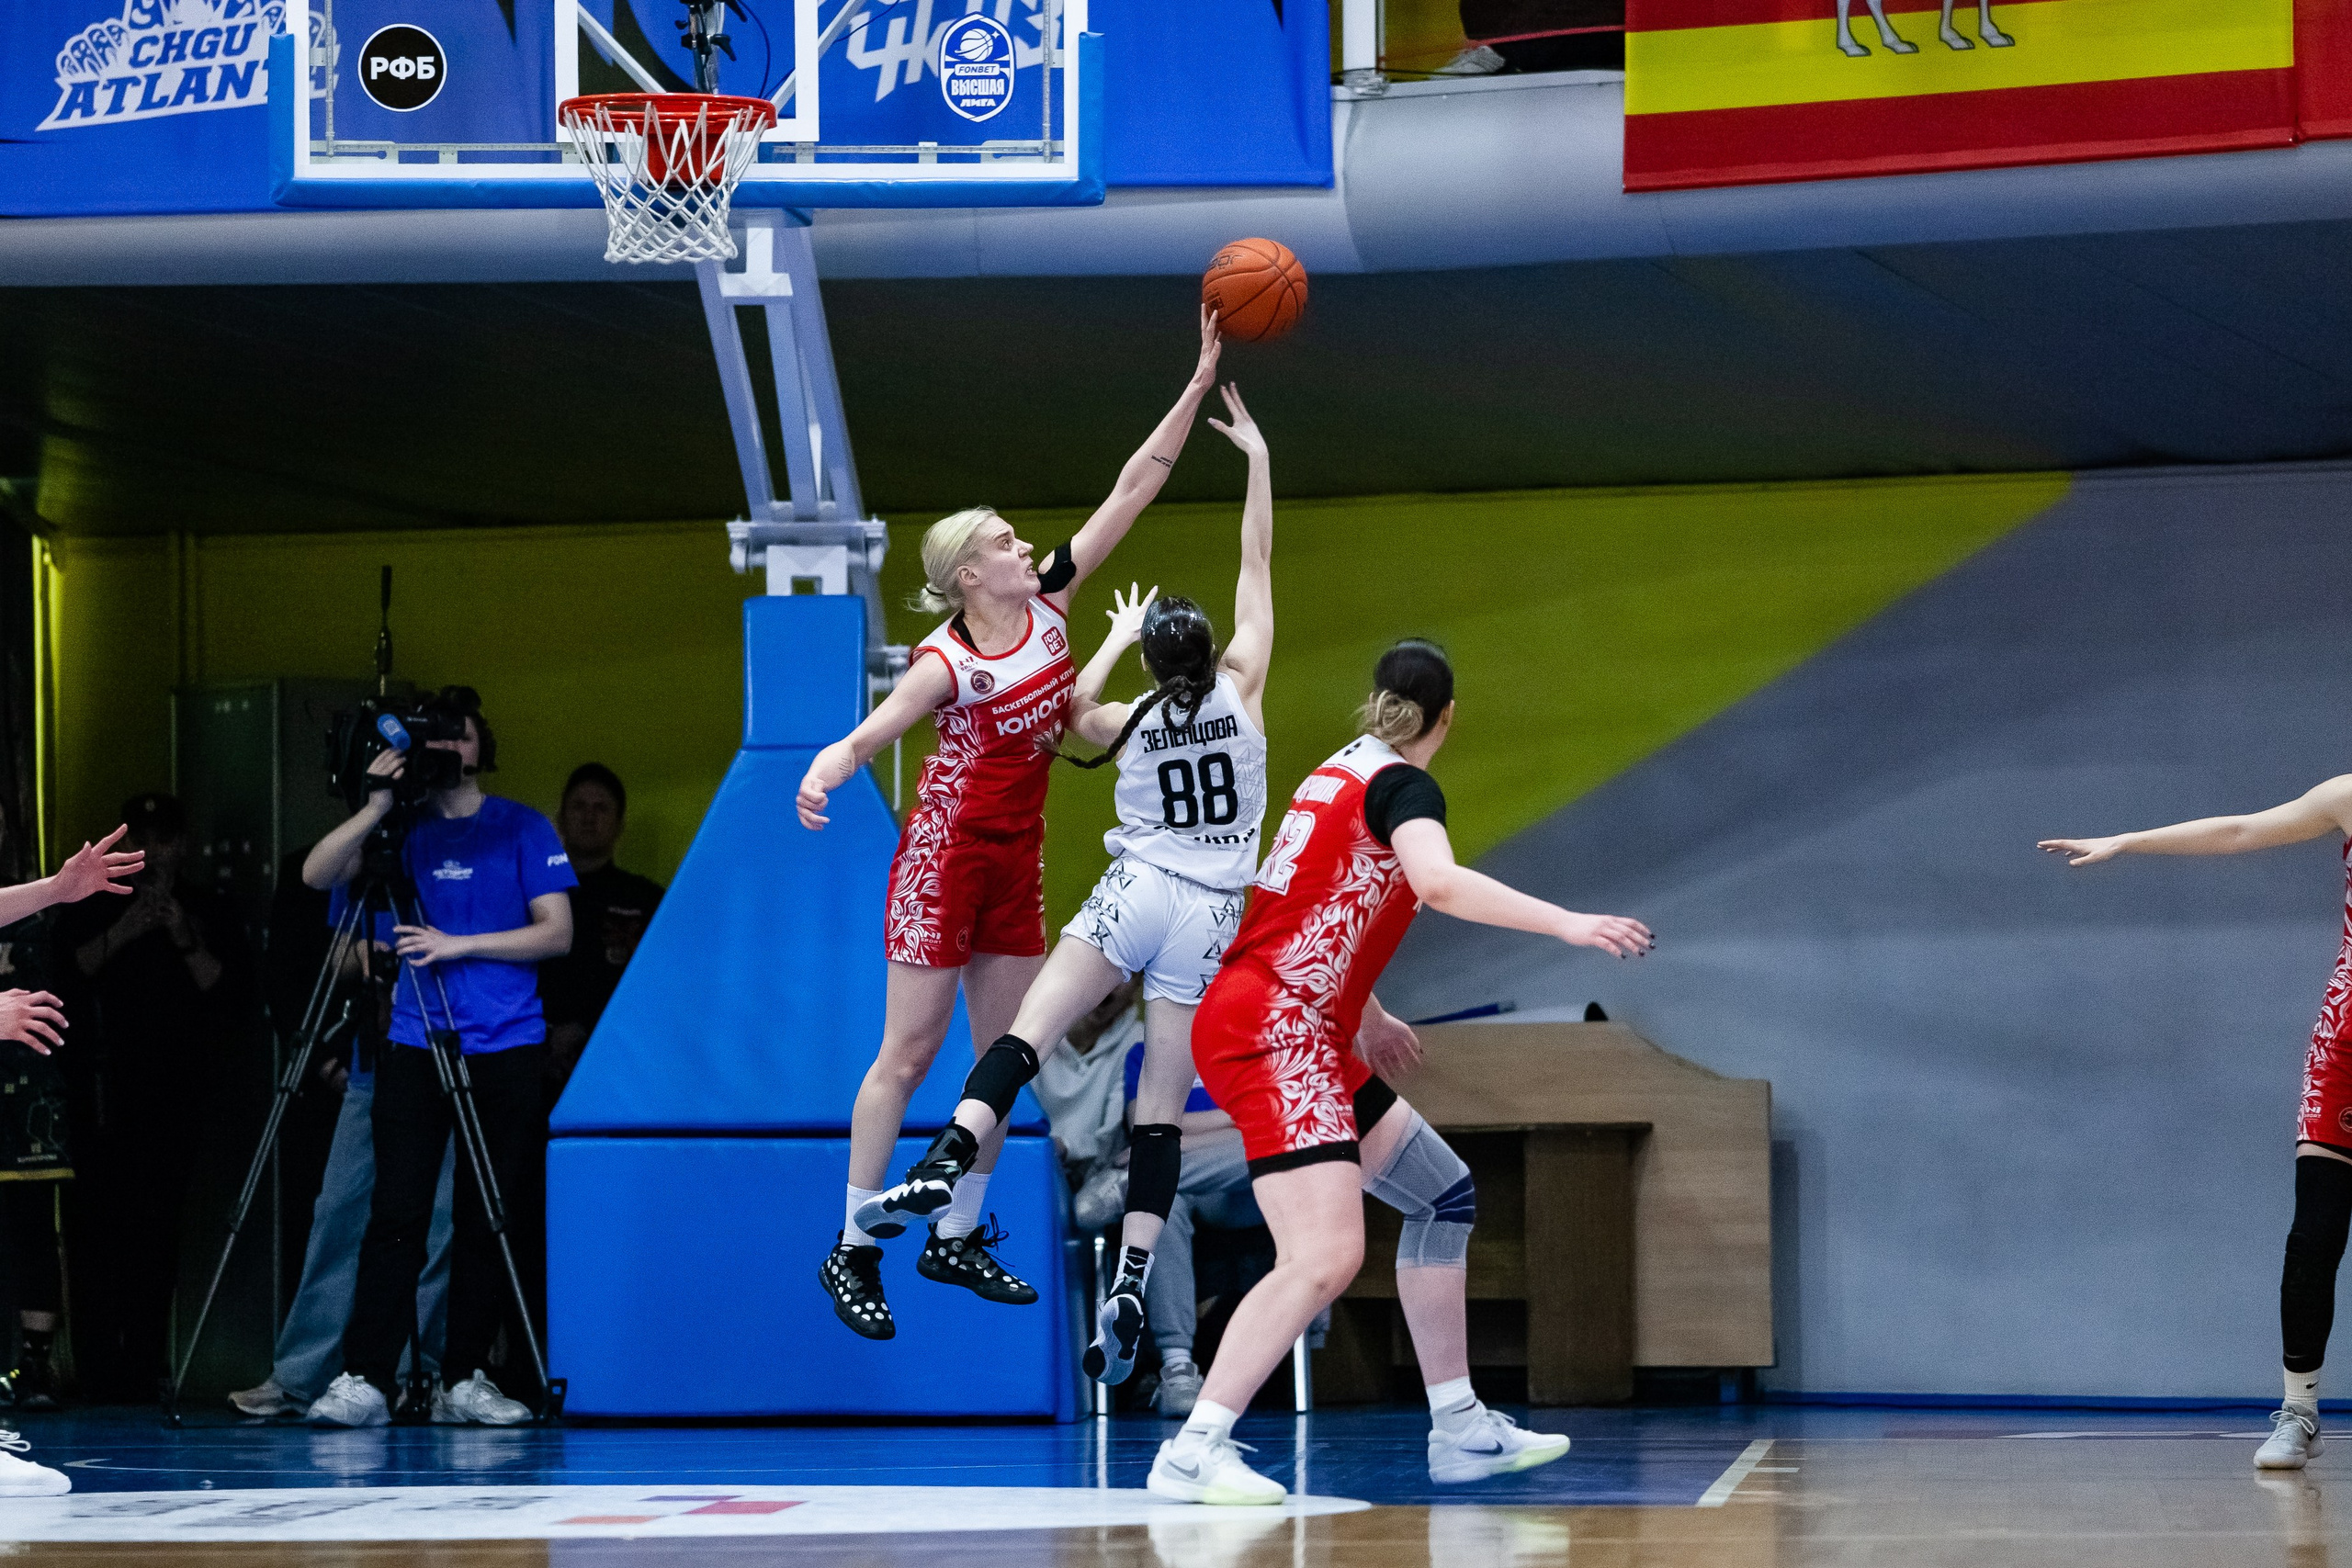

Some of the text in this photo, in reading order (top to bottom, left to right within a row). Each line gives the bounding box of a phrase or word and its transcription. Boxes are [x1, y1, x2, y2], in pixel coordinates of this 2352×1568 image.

[129, 24, 258, 69] CHGU
[370, 56, 435, 80] РФБ
[958, 65, 997, 73] FONBET
[53, 55, 334, 121] ATLAN
[951, 79, 1005, 96] ВЫСШАЯ
[960, 98, 996, 107] ЛИГА
[1044, 628, 1059, 646] FON
[1048, 637, 1064, 653] BET
[992, 677, 1058, 715] БАСКЕТБОЛЬНЫЙ
[1140, 715, 1238, 753] ЗЕЛЕНЦОВА
[1157, 751, 1238, 828] 88
